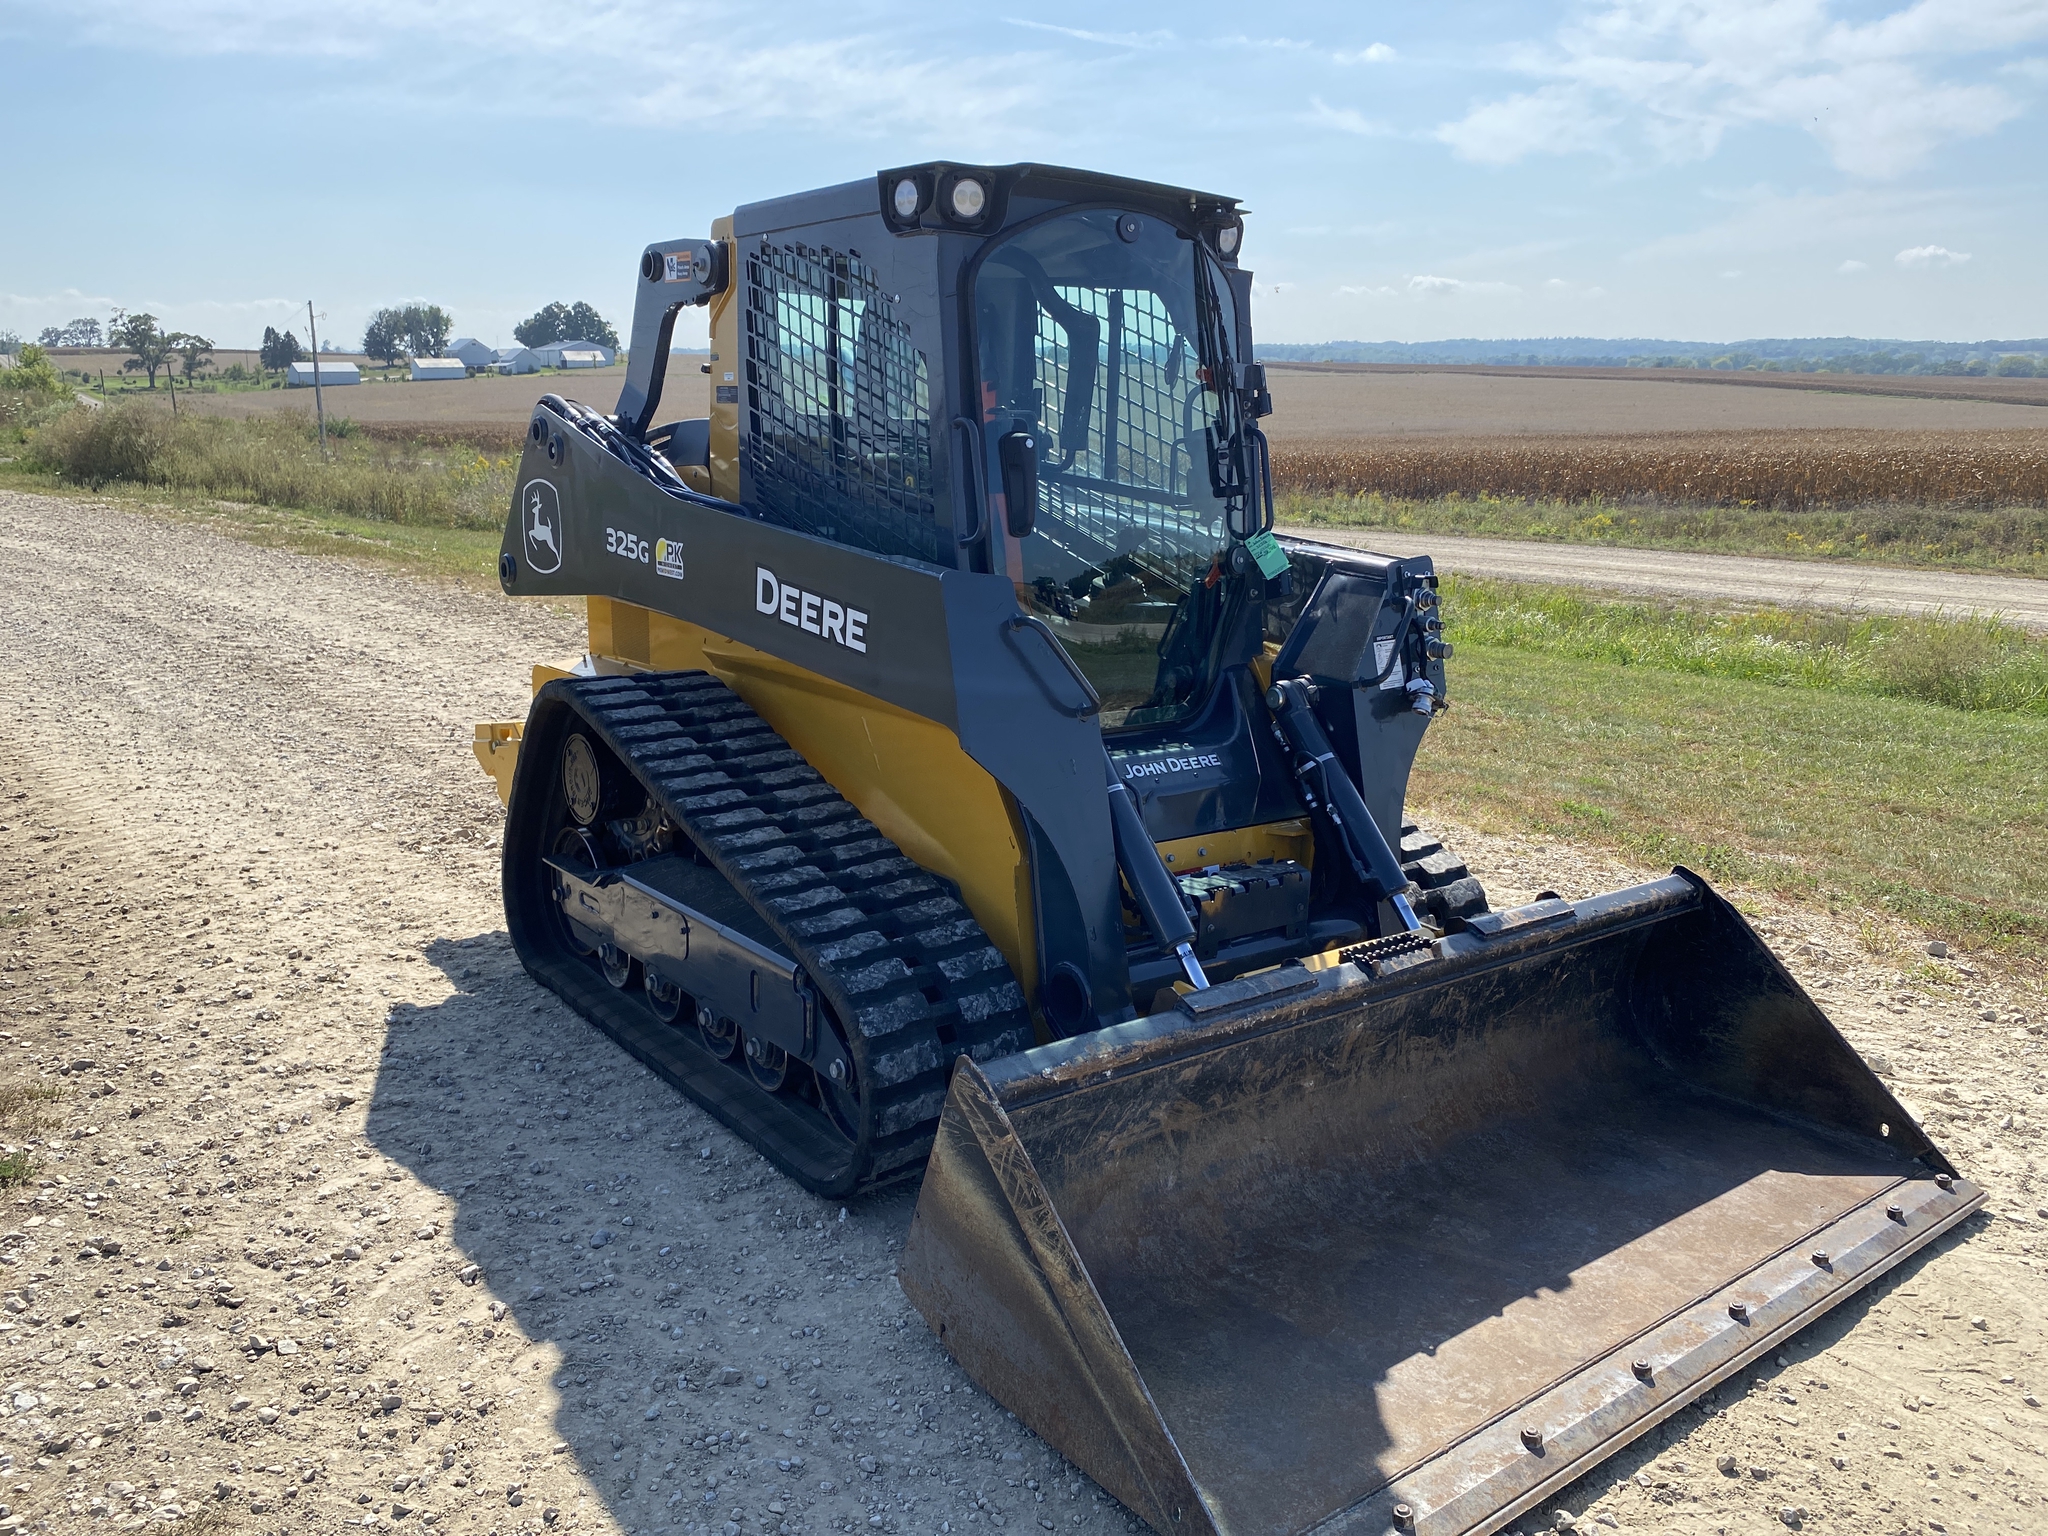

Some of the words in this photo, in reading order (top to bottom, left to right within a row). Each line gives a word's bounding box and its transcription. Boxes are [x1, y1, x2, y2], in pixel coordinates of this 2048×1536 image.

[606, 528, 649, 564] 325G
[756, 566, 868, 654] DEERE
[1125, 762, 1168, 779] JOHN
[1166, 754, 1221, 772] DEERE
